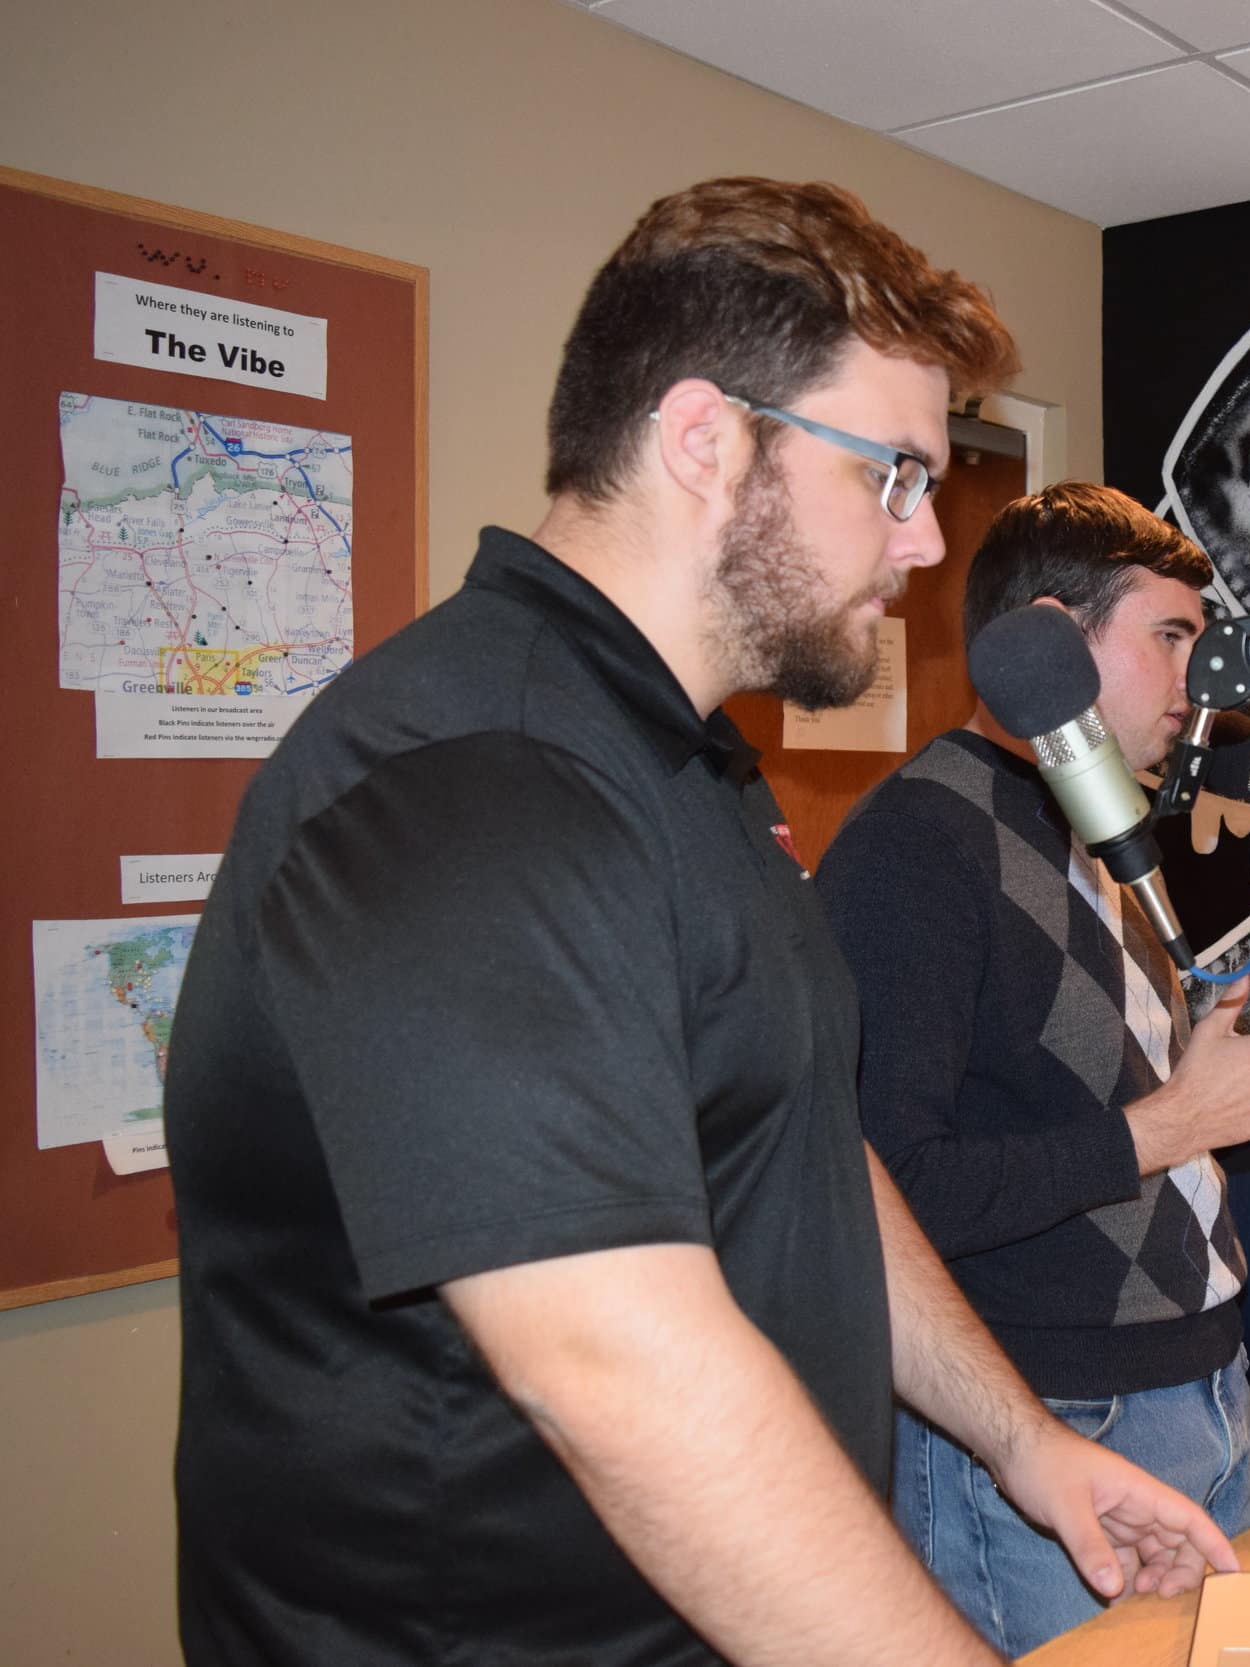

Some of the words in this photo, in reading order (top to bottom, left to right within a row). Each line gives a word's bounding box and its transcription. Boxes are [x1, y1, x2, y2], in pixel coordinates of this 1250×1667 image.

[135, 294, 177, 313] Where
[180, 303, 207, 321] they
[210, 312, 229, 324] are
[233, 314, 280, 337] listening
[283, 325, 295, 337] to
[145, 329, 207, 362] The
[217, 343, 285, 378] Vibe
[128, 406, 137, 416] E.
[140, 408, 157, 419] Flat
[160, 411, 181, 422] Rock
[138, 428, 156, 440] Flat
[159, 431, 180, 443] Rock
[227, 443, 240, 452] 26
[91, 461, 120, 476] BLUE
[132, 456, 161, 474] RIDGE
[195, 454, 227, 467] Tuxedo
[285, 476, 307, 489] Tryon
[258, 654, 282, 663] Greer
[291, 656, 323, 665] Duncan
[241, 667, 272, 679] Taylors
[122, 680, 193, 695] Greenville
[171, 705, 199, 713] Listeners
[201, 705, 206, 713] in
[219, 706, 248, 714] broadcast
[158, 719, 175, 727] Black
[216, 720, 241, 728] listeners
[139, 872, 194, 884] Listeners
